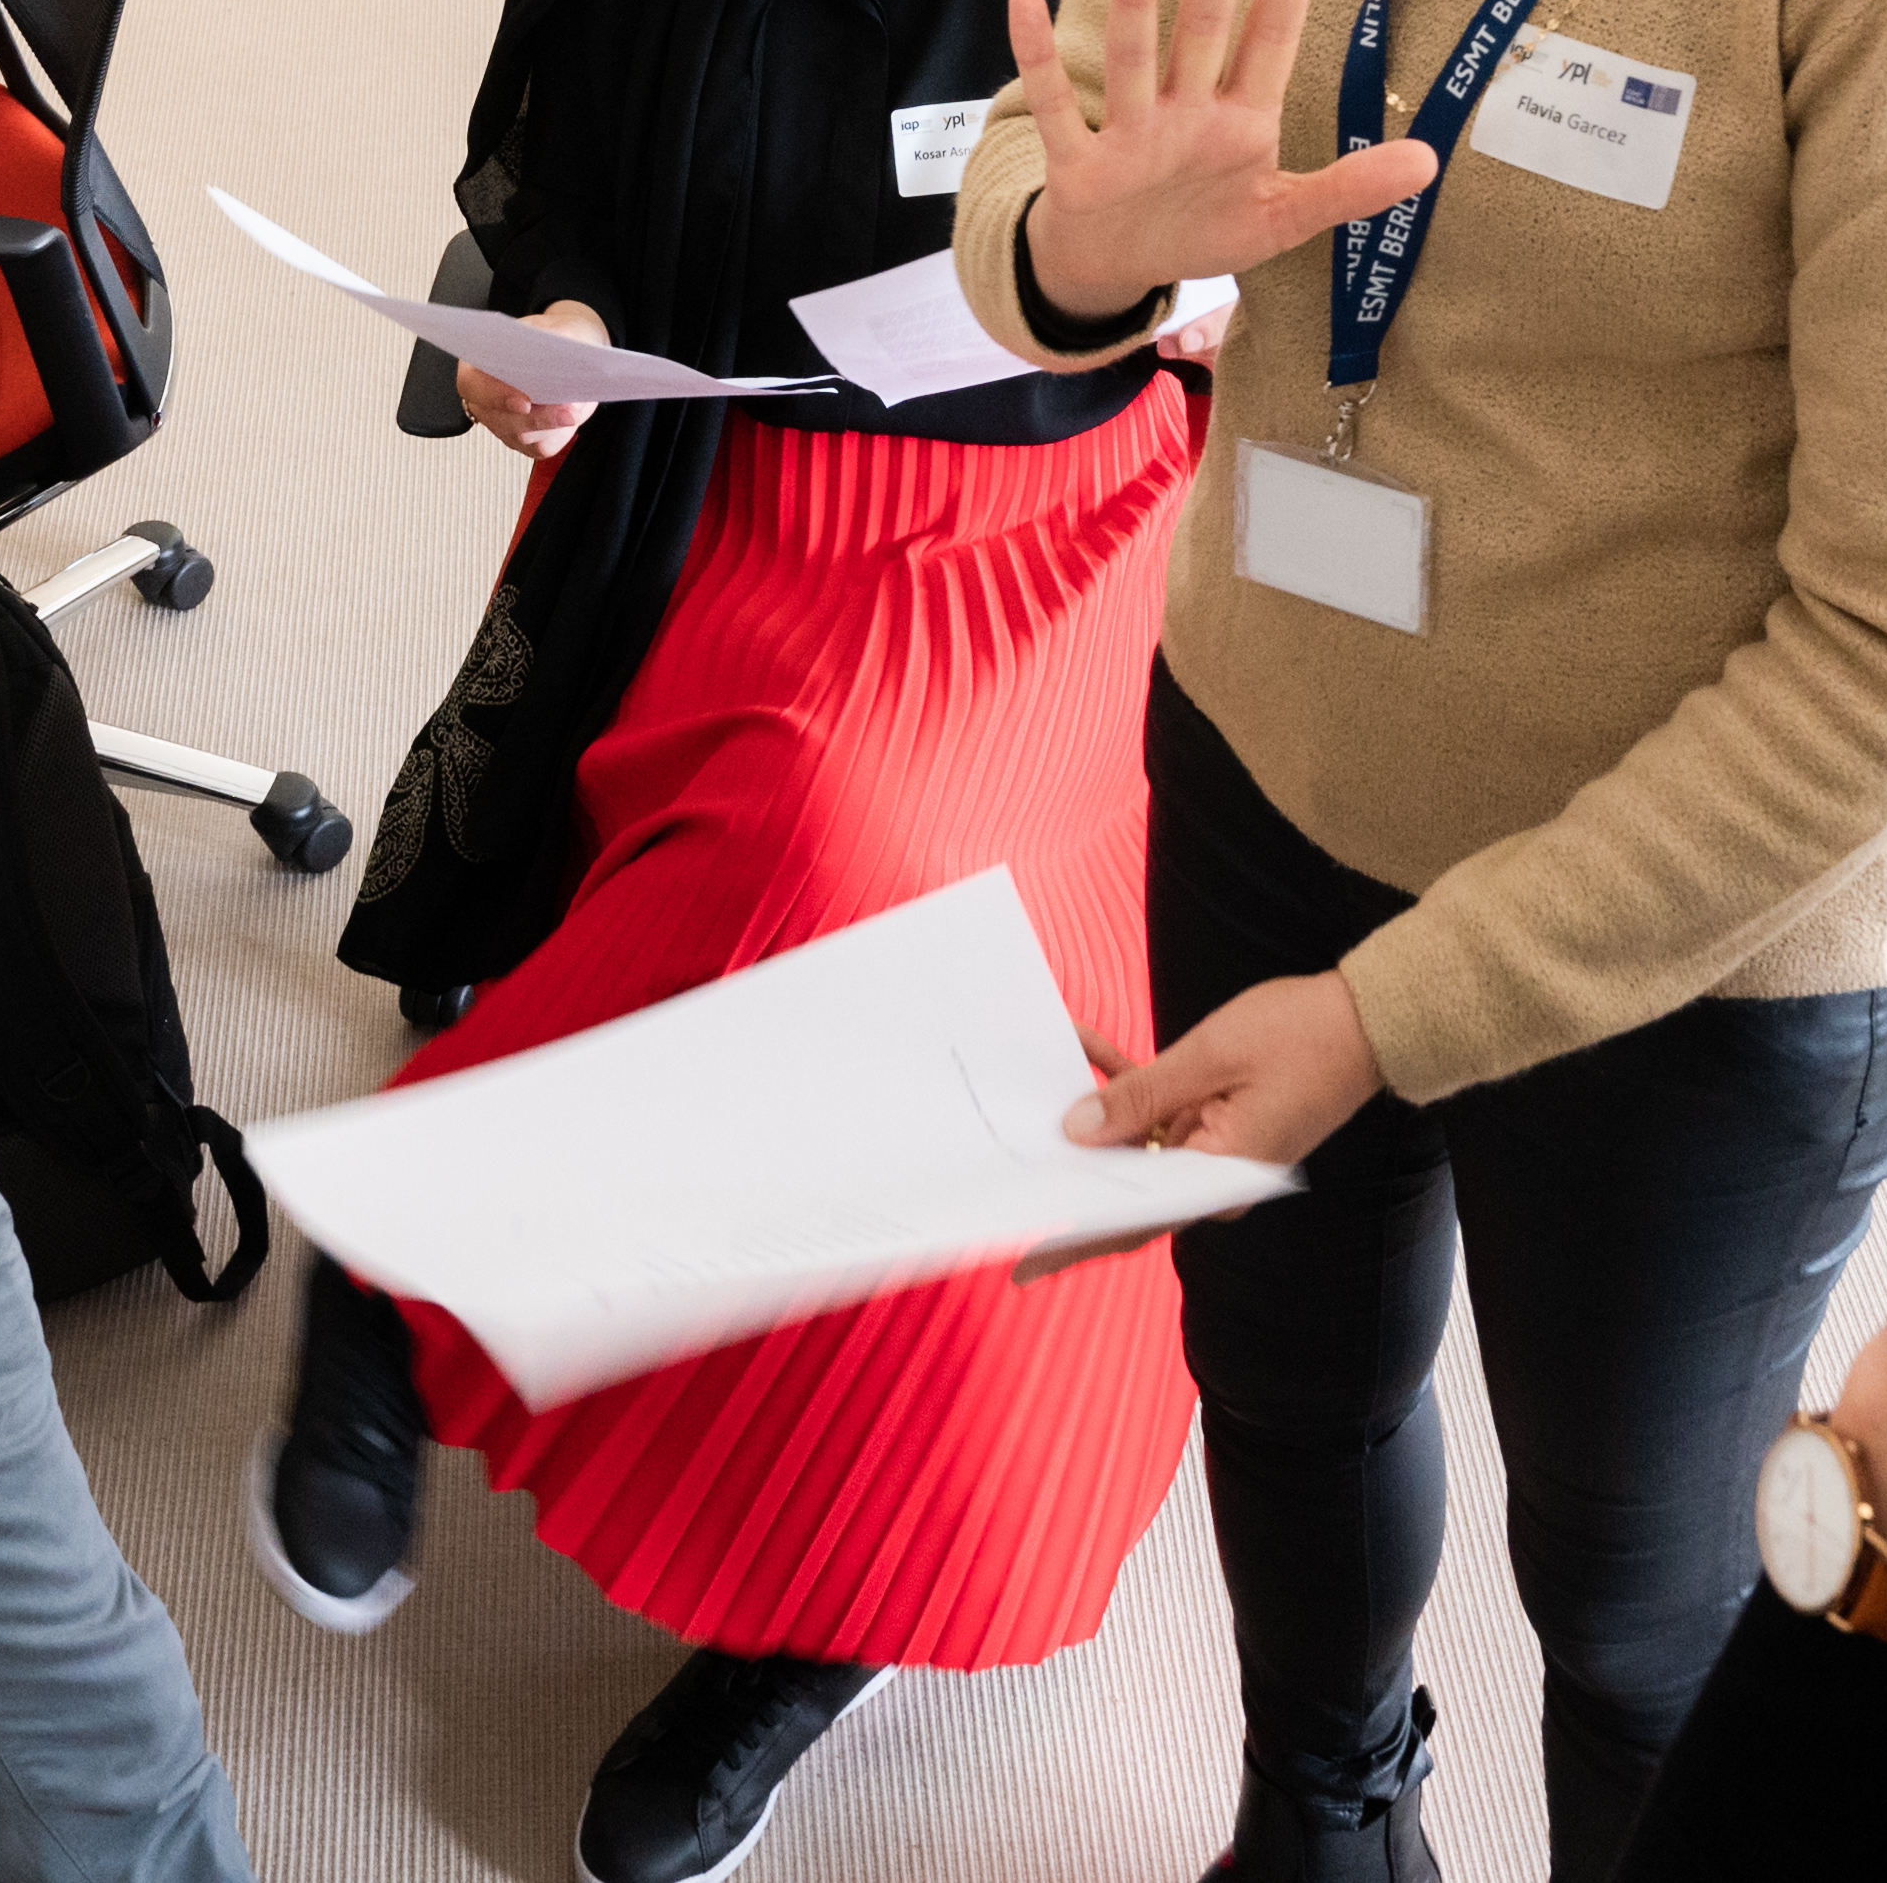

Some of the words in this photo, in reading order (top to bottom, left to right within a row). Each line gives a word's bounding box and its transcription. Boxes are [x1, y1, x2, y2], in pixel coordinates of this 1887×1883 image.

[1445, 24, 1498, 99] ESMT
[1558, 59, 1592, 85] ypl
[901, 120, 920, 132] iap
[943, 112, 966, 131] ypl
[1517, 94, 1563, 124] Flavia
[1566, 113, 1628, 146] Garcez
[914, 149, 947, 161] Kosar
[950, 146, 973, 157] Asn
[1357, 260, 1397, 323] ESMT
